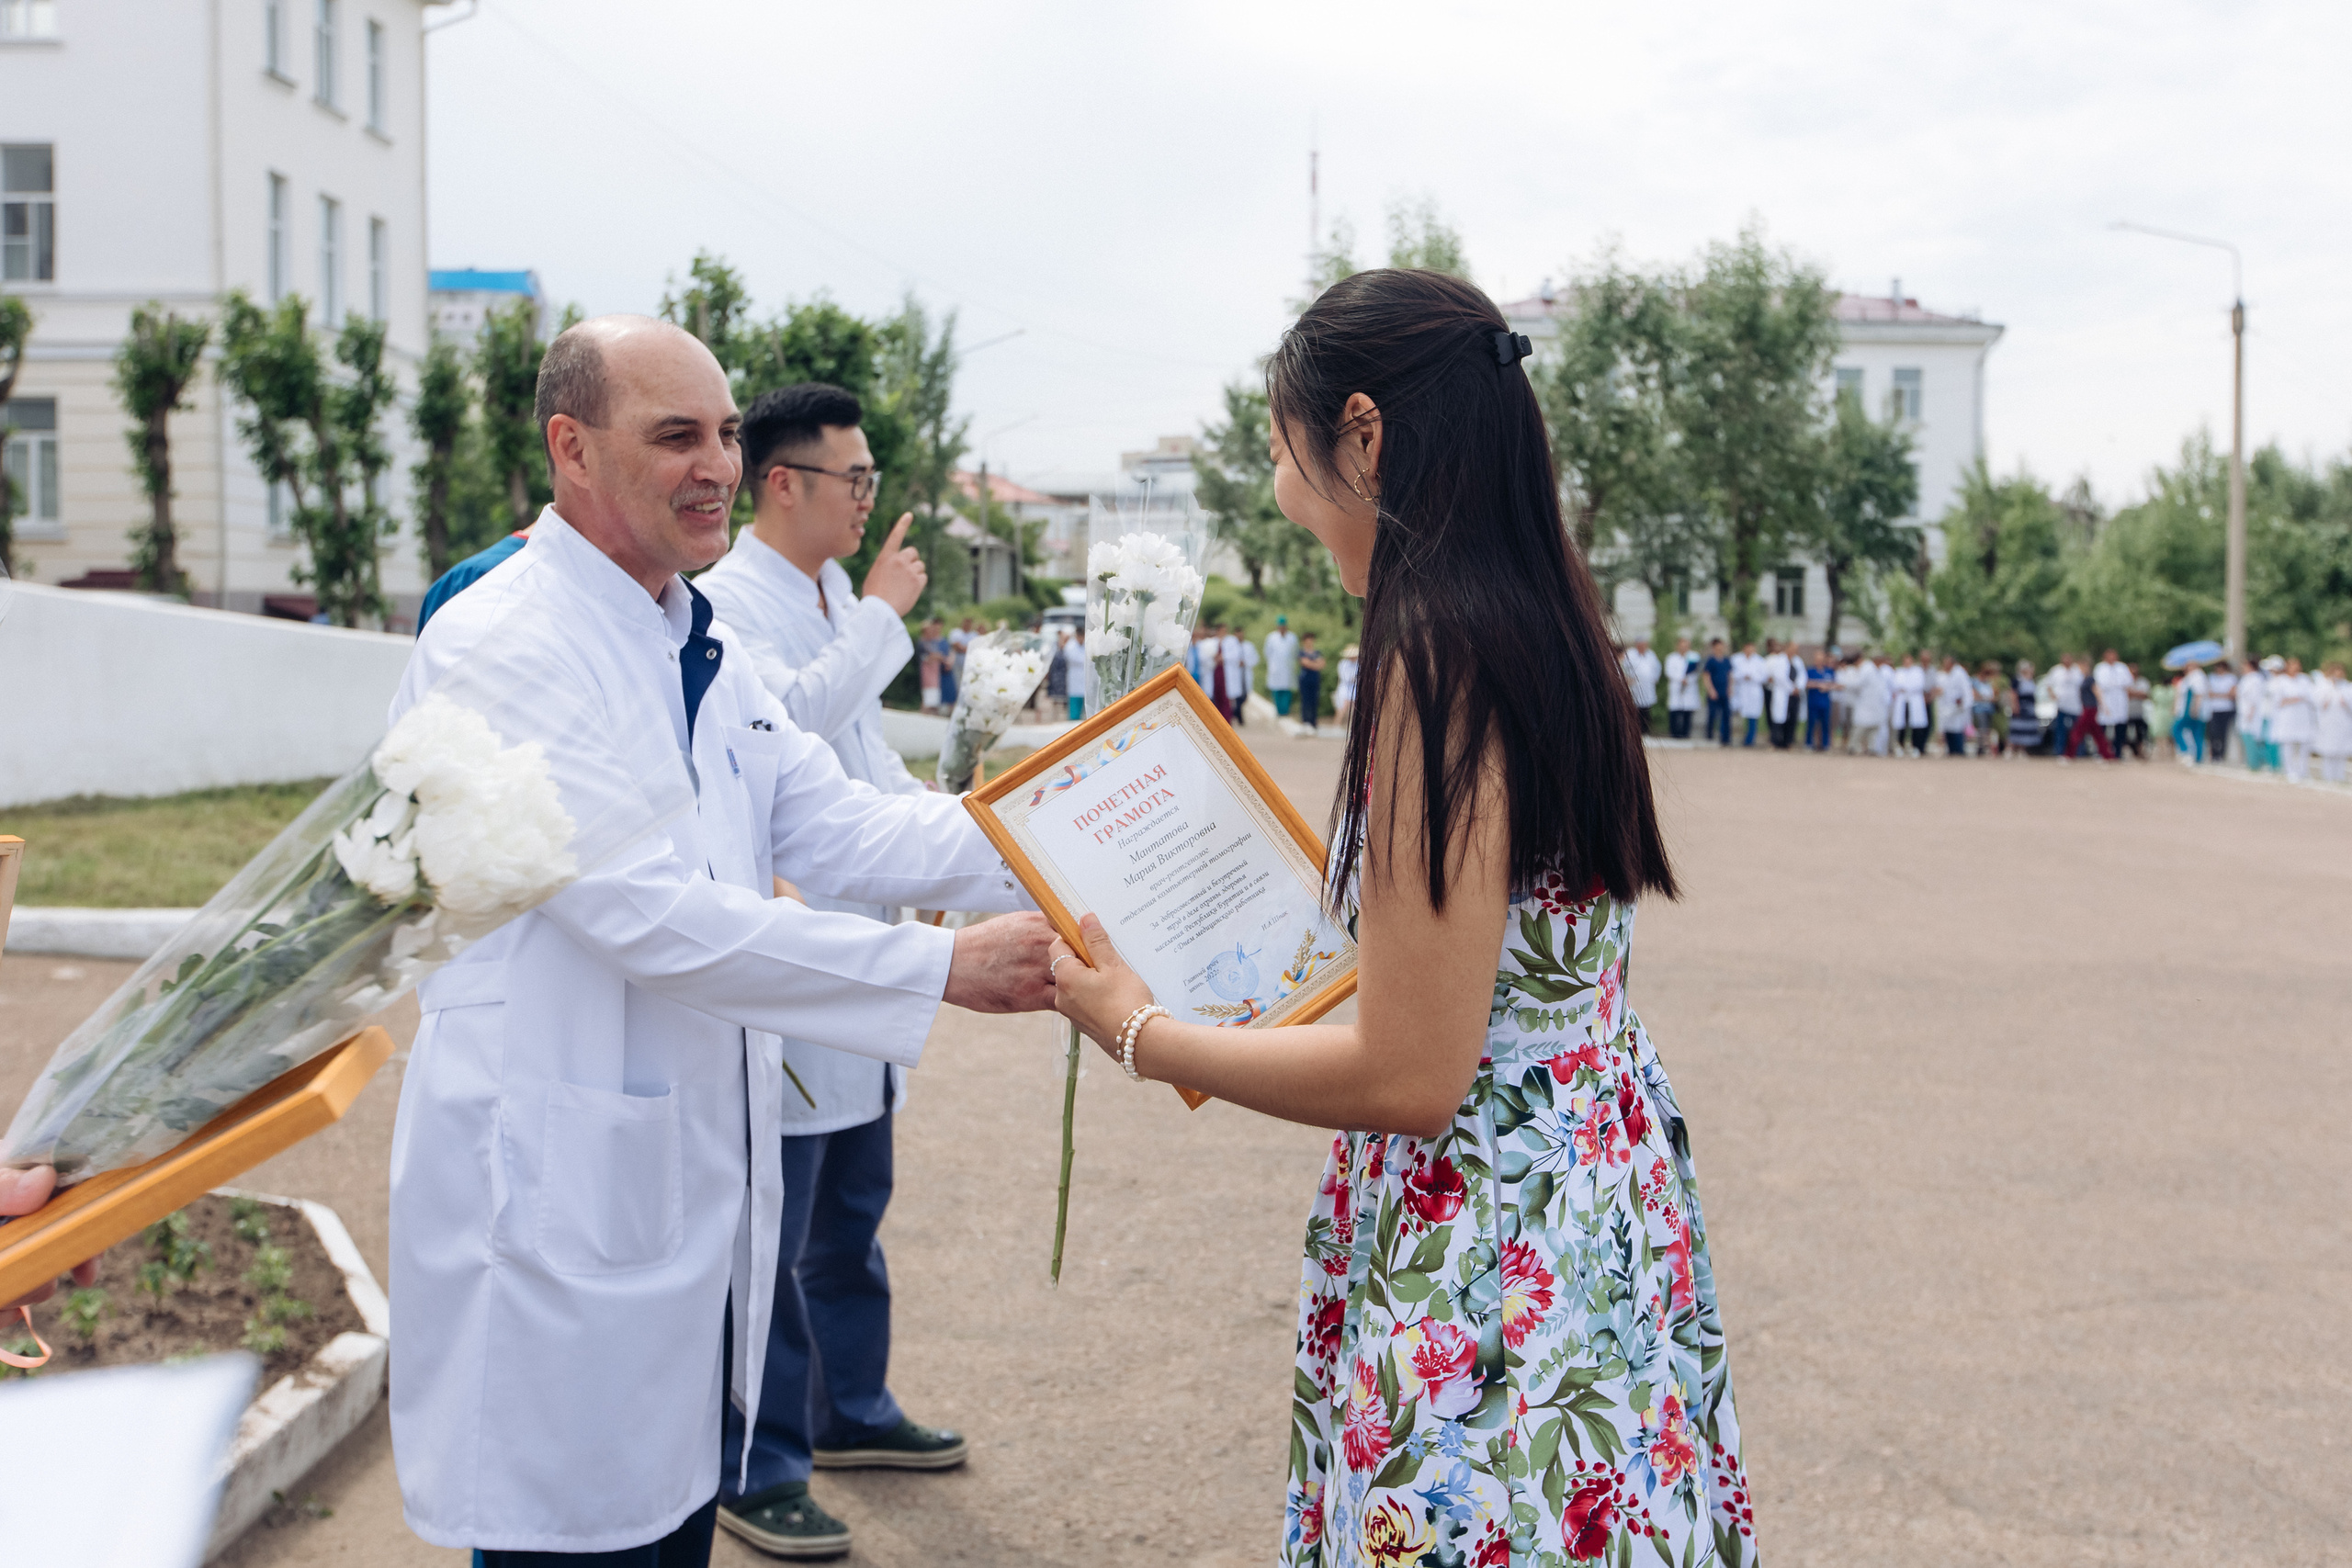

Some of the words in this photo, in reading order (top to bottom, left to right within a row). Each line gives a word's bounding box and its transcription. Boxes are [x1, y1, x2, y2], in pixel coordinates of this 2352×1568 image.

[1072, 763, 1168, 831] ПОЧЕТНАЯ
[1092, 788, 1175, 845] ГРАМОТА
[1116, 805, 1180, 850] Награждается
[1123, 862, 1158, 888] Мария
[1156, 821, 1217, 865] Викторовна
[1128, 821, 1189, 865] Мантатова
[1149, 847, 1210, 892] врач-рентгенолог
[1119, 897, 1158, 926] отделения
[1157, 860, 1209, 900] компьютерной
[1208, 832, 1252, 865] томографии
[1159, 887, 1207, 923] добросовестный
[1210, 859, 1249, 888] безупречный
[1166, 917, 1182, 931] труд
[1199, 891, 1222, 909] охраны
[1221, 874, 1248, 895] здоровья
[1154, 930, 1185, 953] населения
[1183, 907, 1218, 932] Республики
[1216, 888, 1245, 909] Бурятии
[1253, 871, 1270, 886] связи
[1177, 935, 1195, 950] Днем
[1195, 908, 1235, 939] медицинского
[1234, 886, 1266, 913] работника
